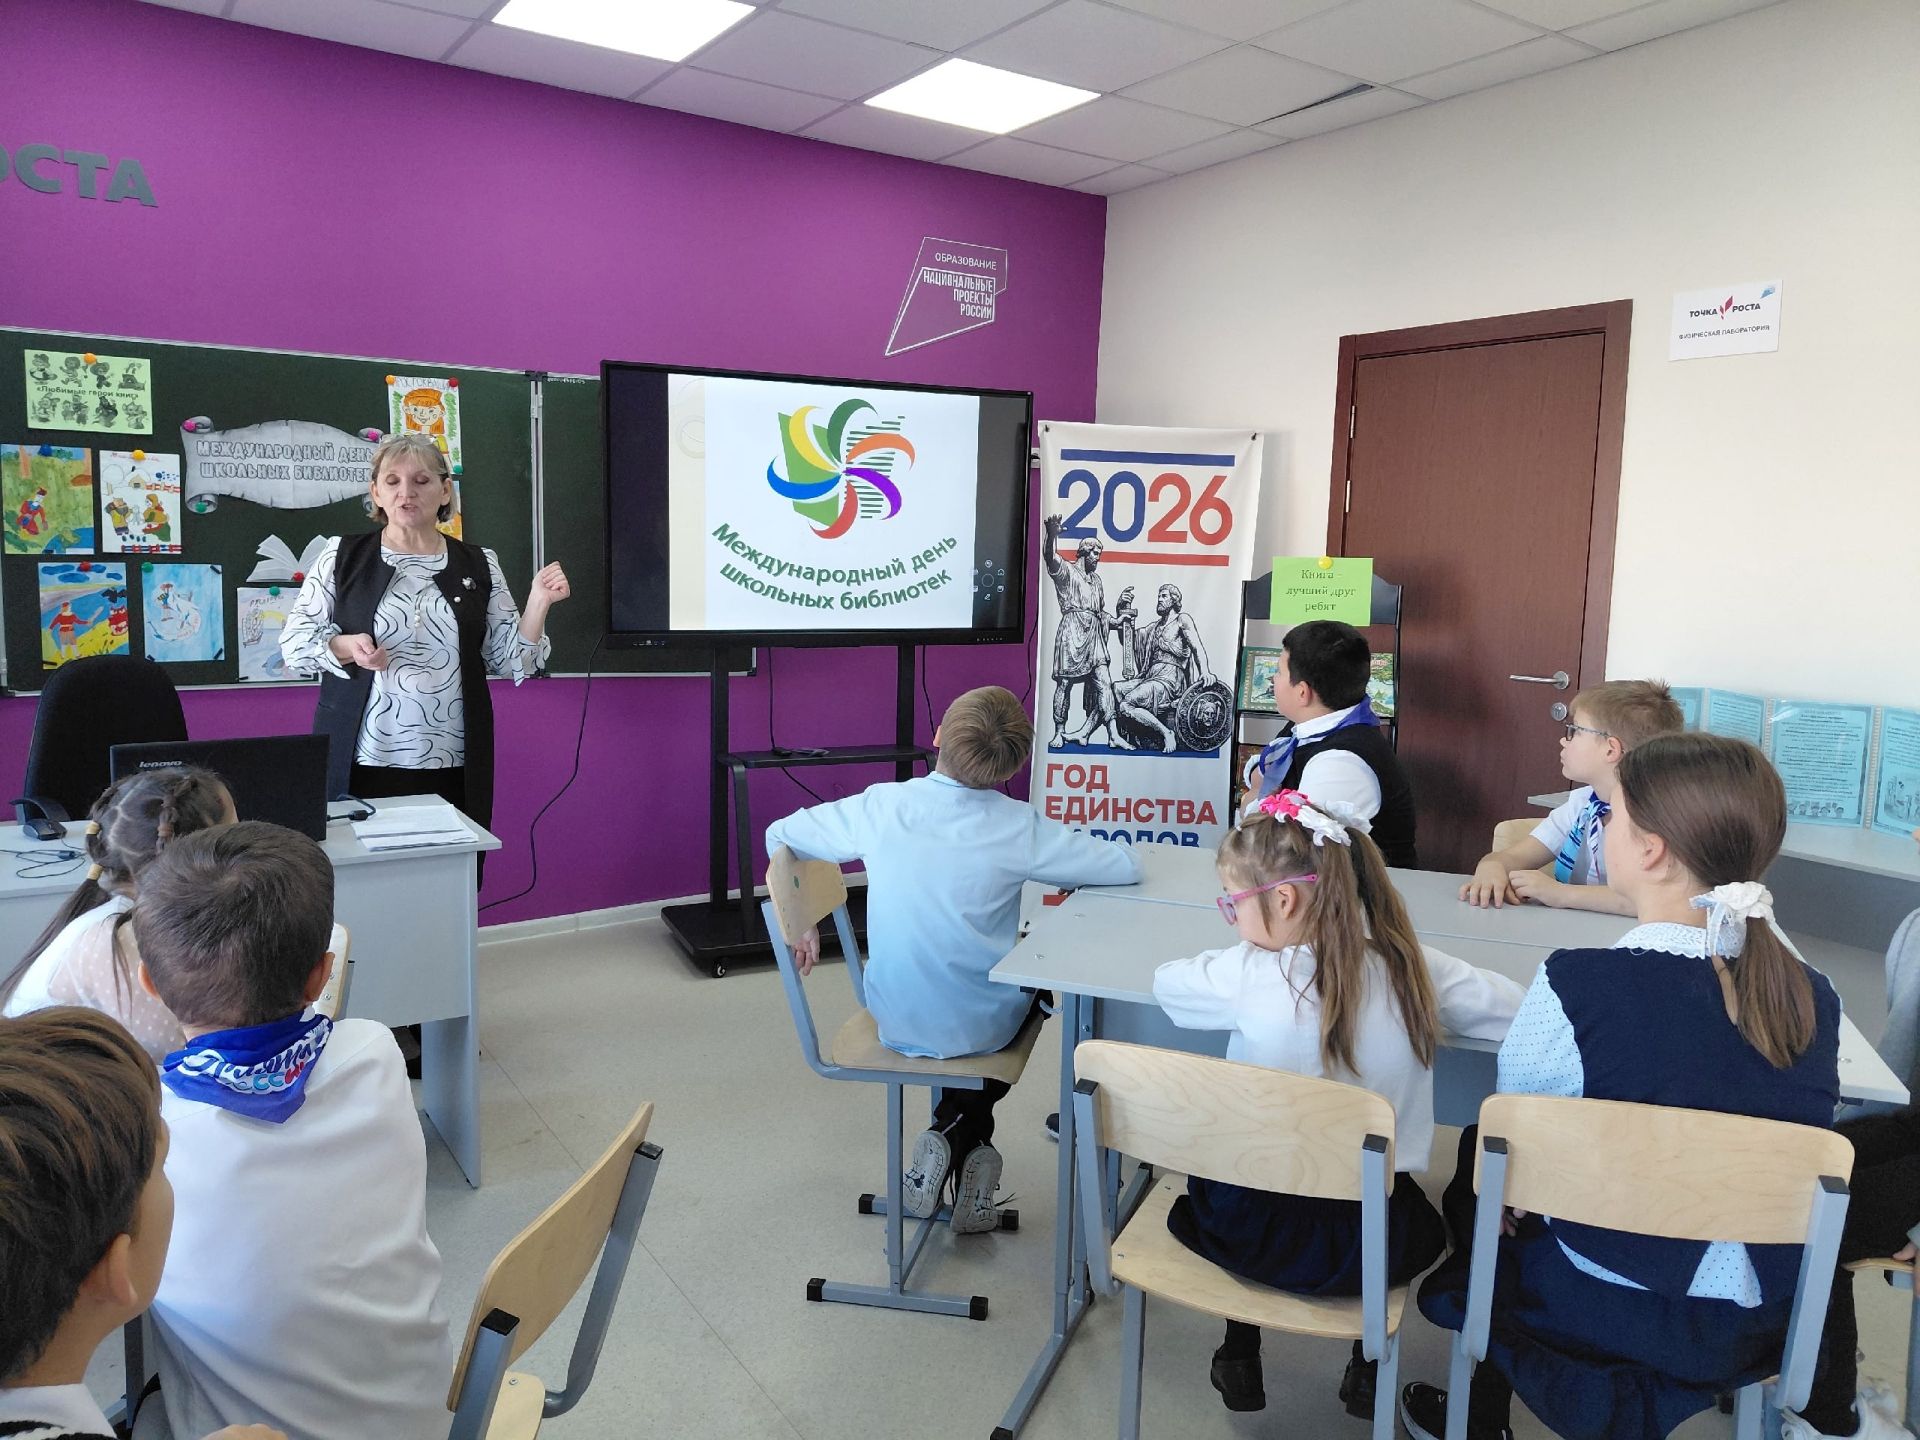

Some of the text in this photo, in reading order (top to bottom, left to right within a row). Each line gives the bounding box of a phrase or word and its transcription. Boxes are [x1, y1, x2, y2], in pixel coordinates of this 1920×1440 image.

[0, 143, 159, 208] СТА
[934, 252, 997, 271] ОБРАЗОВАНИЕ
[923, 270, 993, 293] НАЦИОНАЛЬНЫЕ
[953, 288, 993, 306] ПРОЕКТЫ
[960, 303, 992, 319] РОССИИ
[1689, 303, 1761, 318] ТОЧКА РОСТА
[1679, 324, 1770, 340] ФИЗИЧЕСКАЯ ЛАБОРАТОРИЯ
[36, 385, 86, 396] «Любимые
[88, 389, 114, 399] герои
[196, 440, 374, 464] МЕЖДУНАРОДНЫЙ ДЕНЬ
[200, 462, 291, 481] ШКОЛЬНЫХ
[1057, 469, 1233, 546] 2026
[711, 522, 958, 587] Международный день
[1301, 569, 1334, 580] Книга
[719, 562, 953, 610] школьных библиотек
[1285, 586, 1357, 598] лучший друг
[1305, 601, 1337, 613] ребят
[139, 760, 183, 768] lenovo
[1045, 763, 1110, 794] ГОД
[1045, 795, 1218, 825] ЕДИНСТВА
